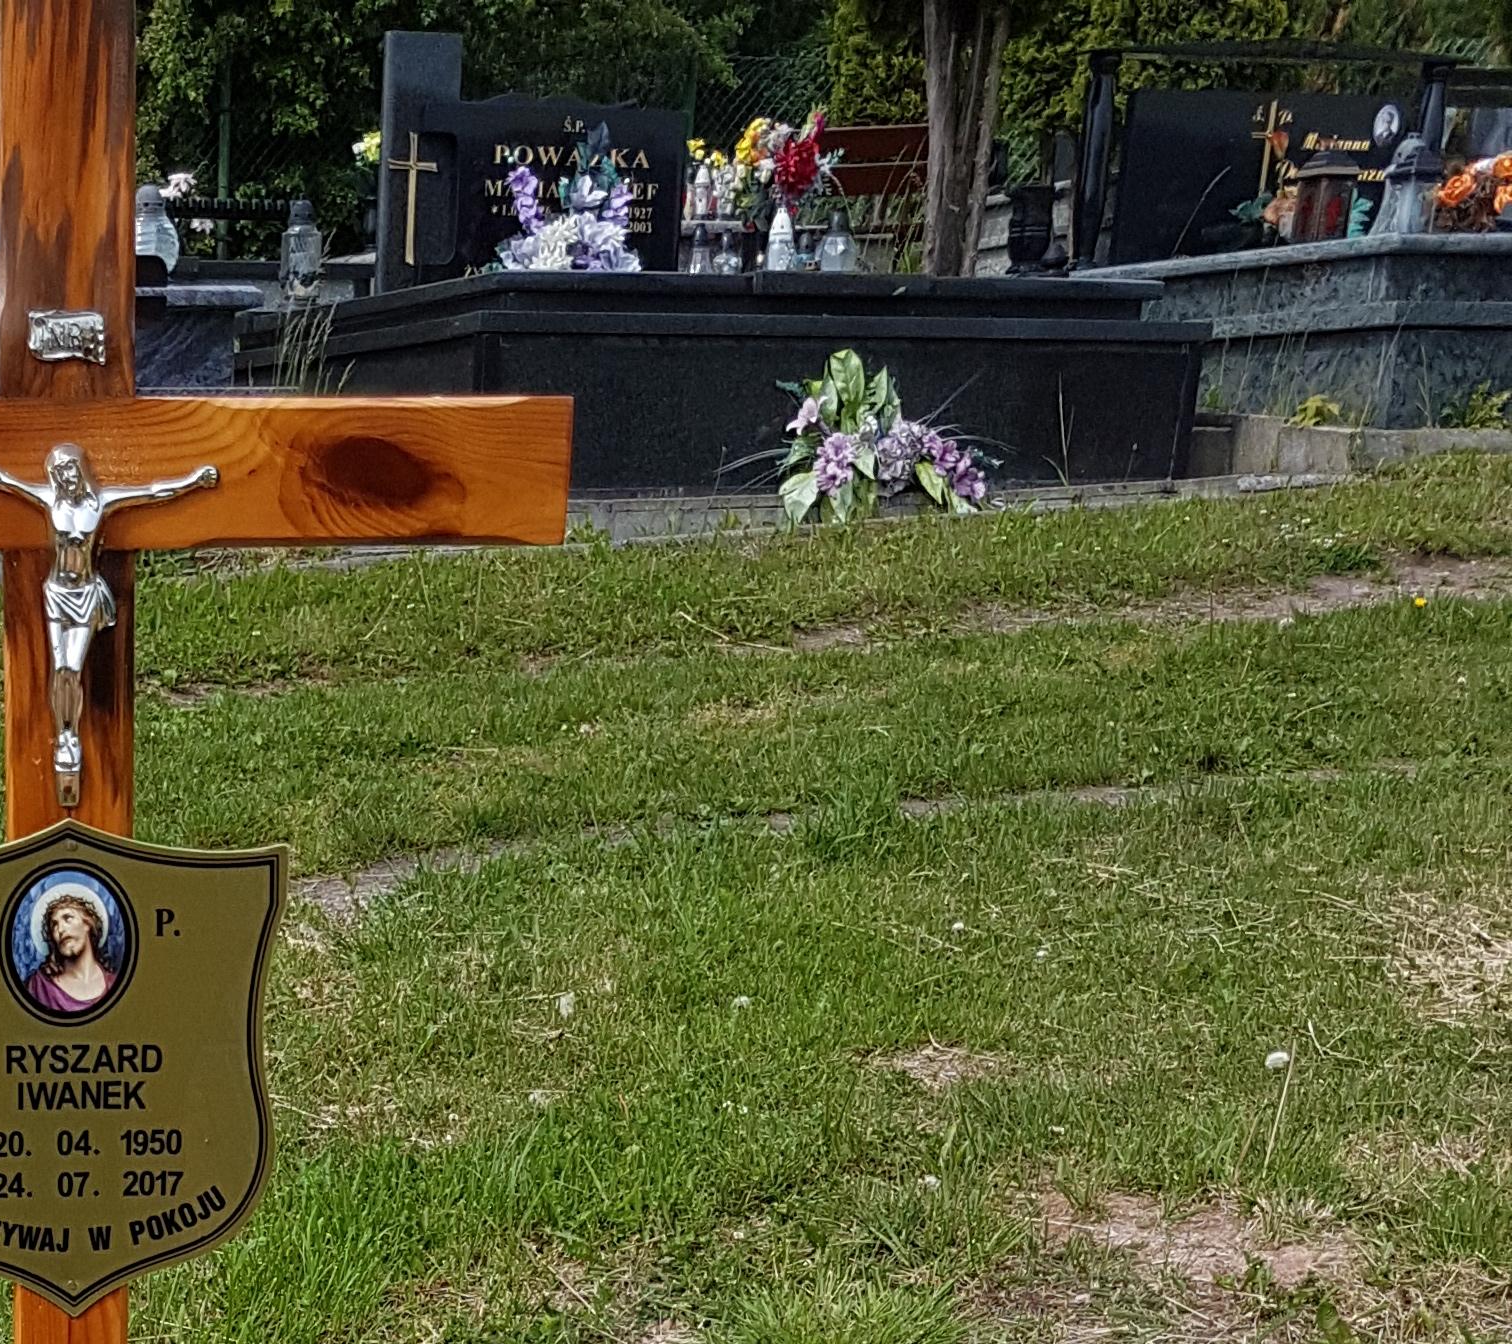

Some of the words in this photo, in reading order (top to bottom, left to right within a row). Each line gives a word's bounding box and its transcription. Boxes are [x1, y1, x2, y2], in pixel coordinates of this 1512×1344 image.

[155, 908, 181, 937] P.
[5, 1044, 163, 1074] RYSZARD
[17, 1080, 146, 1110] IWANEK
[57, 1130, 101, 1156] 04.
[120, 1129, 182, 1155] 1950
[57, 1172, 100, 1198] 07.
[122, 1171, 184, 1196] 2017
[88, 1226, 111, 1251] W
[129, 1185, 227, 1245] POKOJU
